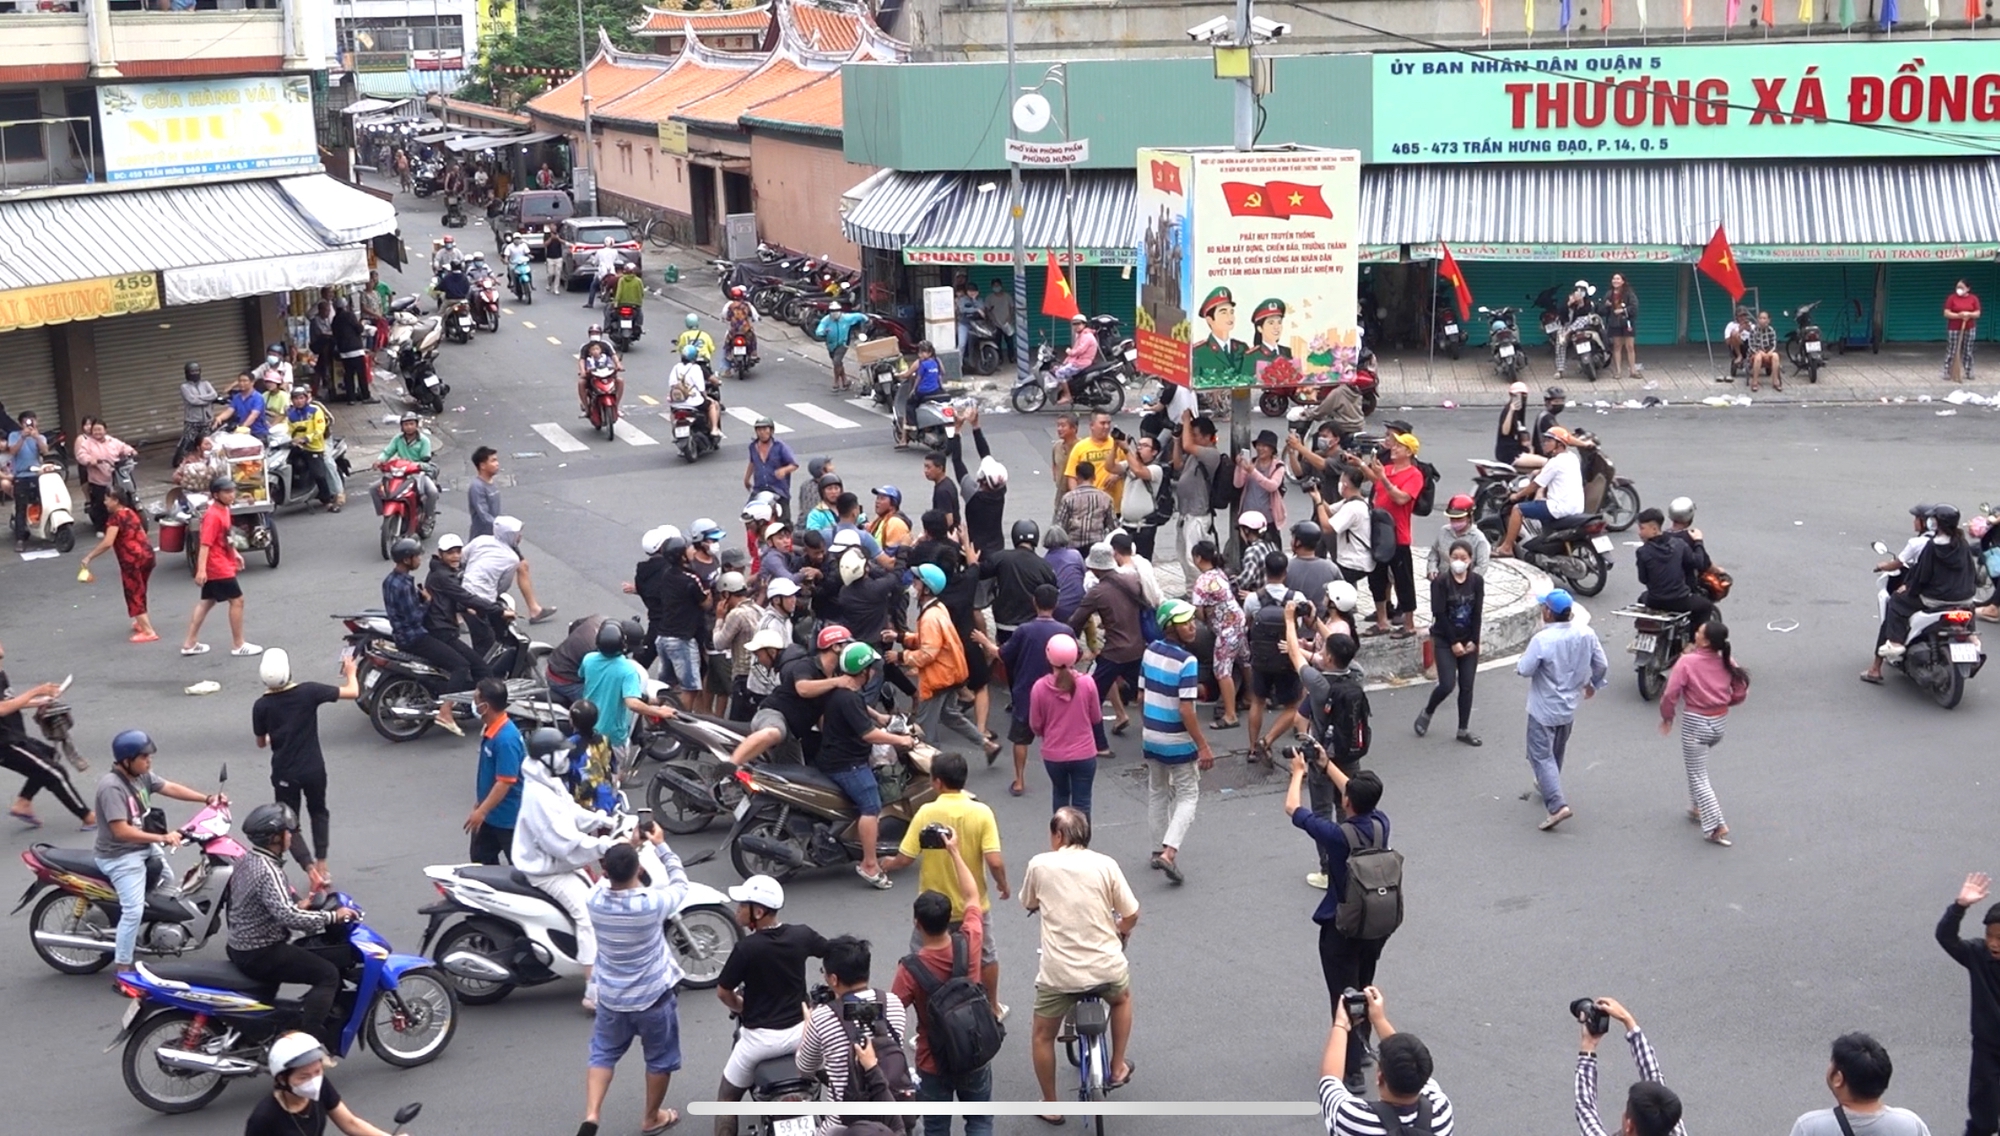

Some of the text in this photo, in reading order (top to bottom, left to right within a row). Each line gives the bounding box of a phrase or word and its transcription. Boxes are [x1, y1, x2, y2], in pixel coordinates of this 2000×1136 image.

[1391, 56, 1661, 75] ỦY BAN NHÂN DÂN QUẬN 5
[142, 82, 277, 110] CỬA HÀNG VẢI
[1505, 58, 2000, 129] THƯƠNG XÁ ĐỒNG
[1392, 143, 1420, 154] 465
[1431, 142, 1458, 154] 473
[1463, 137, 1502, 153] TRẦN
[1508, 140, 1551, 152] HƯNG
[1557, 139, 1592, 155] ĐẠO,
[1599, 140, 1611, 150] P.
[1614, 139, 1635, 151] 14,
[1640, 139, 1654, 150] Q.
[1659, 139, 1669, 150] 5
[907, 252, 976, 263] TRUNG
[983, 252, 1038, 263] QUY
[1272, 254, 1289, 262] CÔNG
[1291, 254, 1300, 262] AN
[1301, 253, 1318, 261] NHÂN
[1319, 253, 1332, 261] DÂN
[1891, 249, 1931, 259] TRANG
[114, 275, 153, 290] 459
[25, 287, 110, 321] NHUNG
